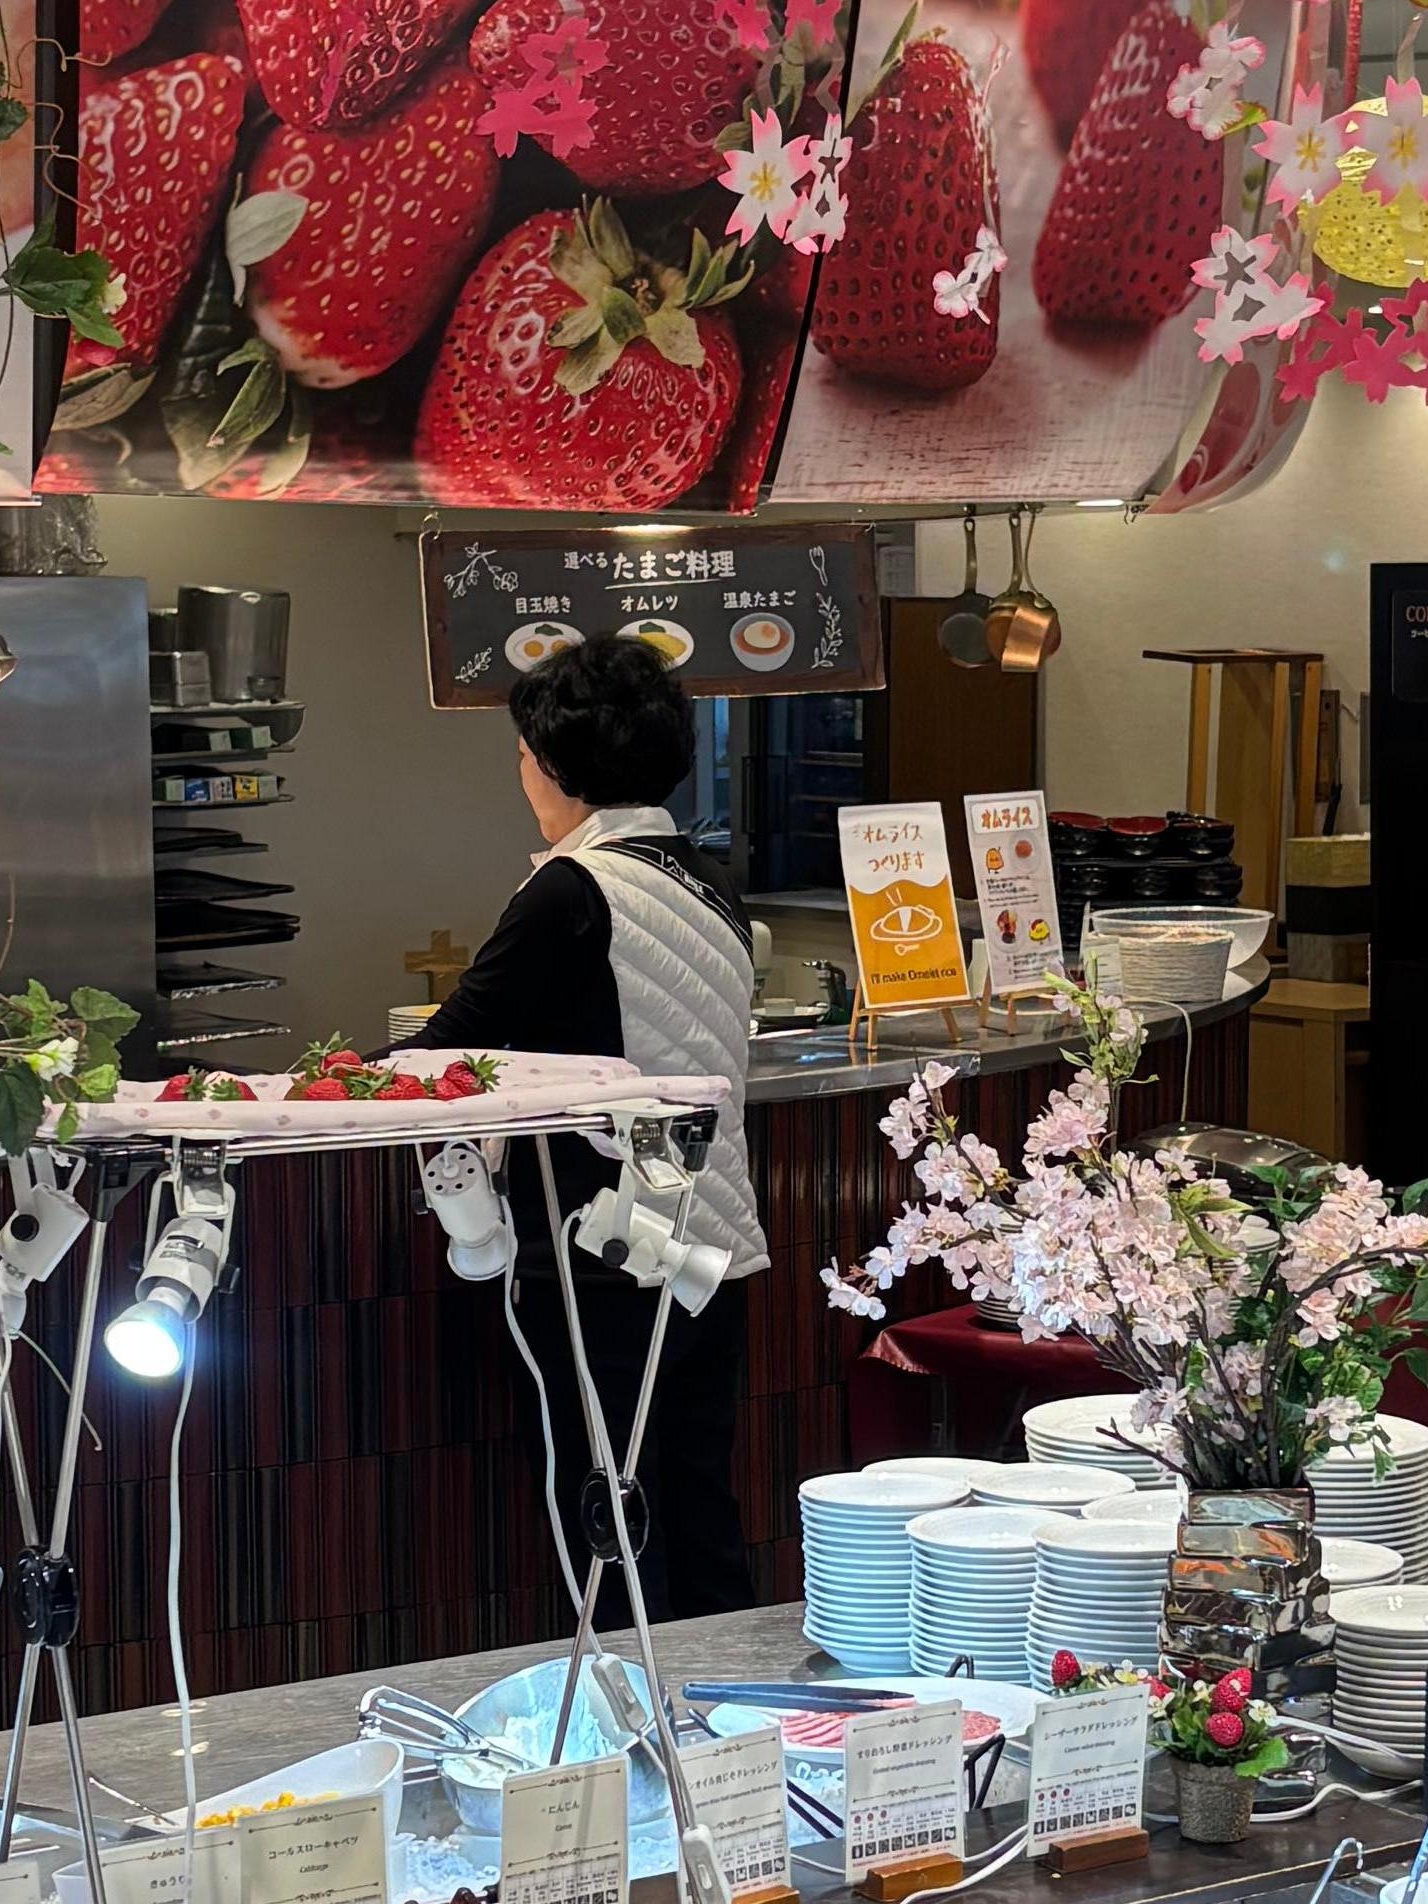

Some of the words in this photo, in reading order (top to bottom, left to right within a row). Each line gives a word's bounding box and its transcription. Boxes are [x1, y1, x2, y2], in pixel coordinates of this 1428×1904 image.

[564, 551, 608, 570] 選べる
[613, 550, 737, 579] たまご料理
[515, 596, 572, 615] 目玉焼き
[621, 595, 679, 613] オムレツ
[723, 590, 797, 609] 温泉たまご
[980, 805, 1033, 829] オムライス
[863, 822, 923, 844] オムライス
[868, 850, 924, 873] つくります
[268, 1835, 359, 1860] コールスローキャベツ
